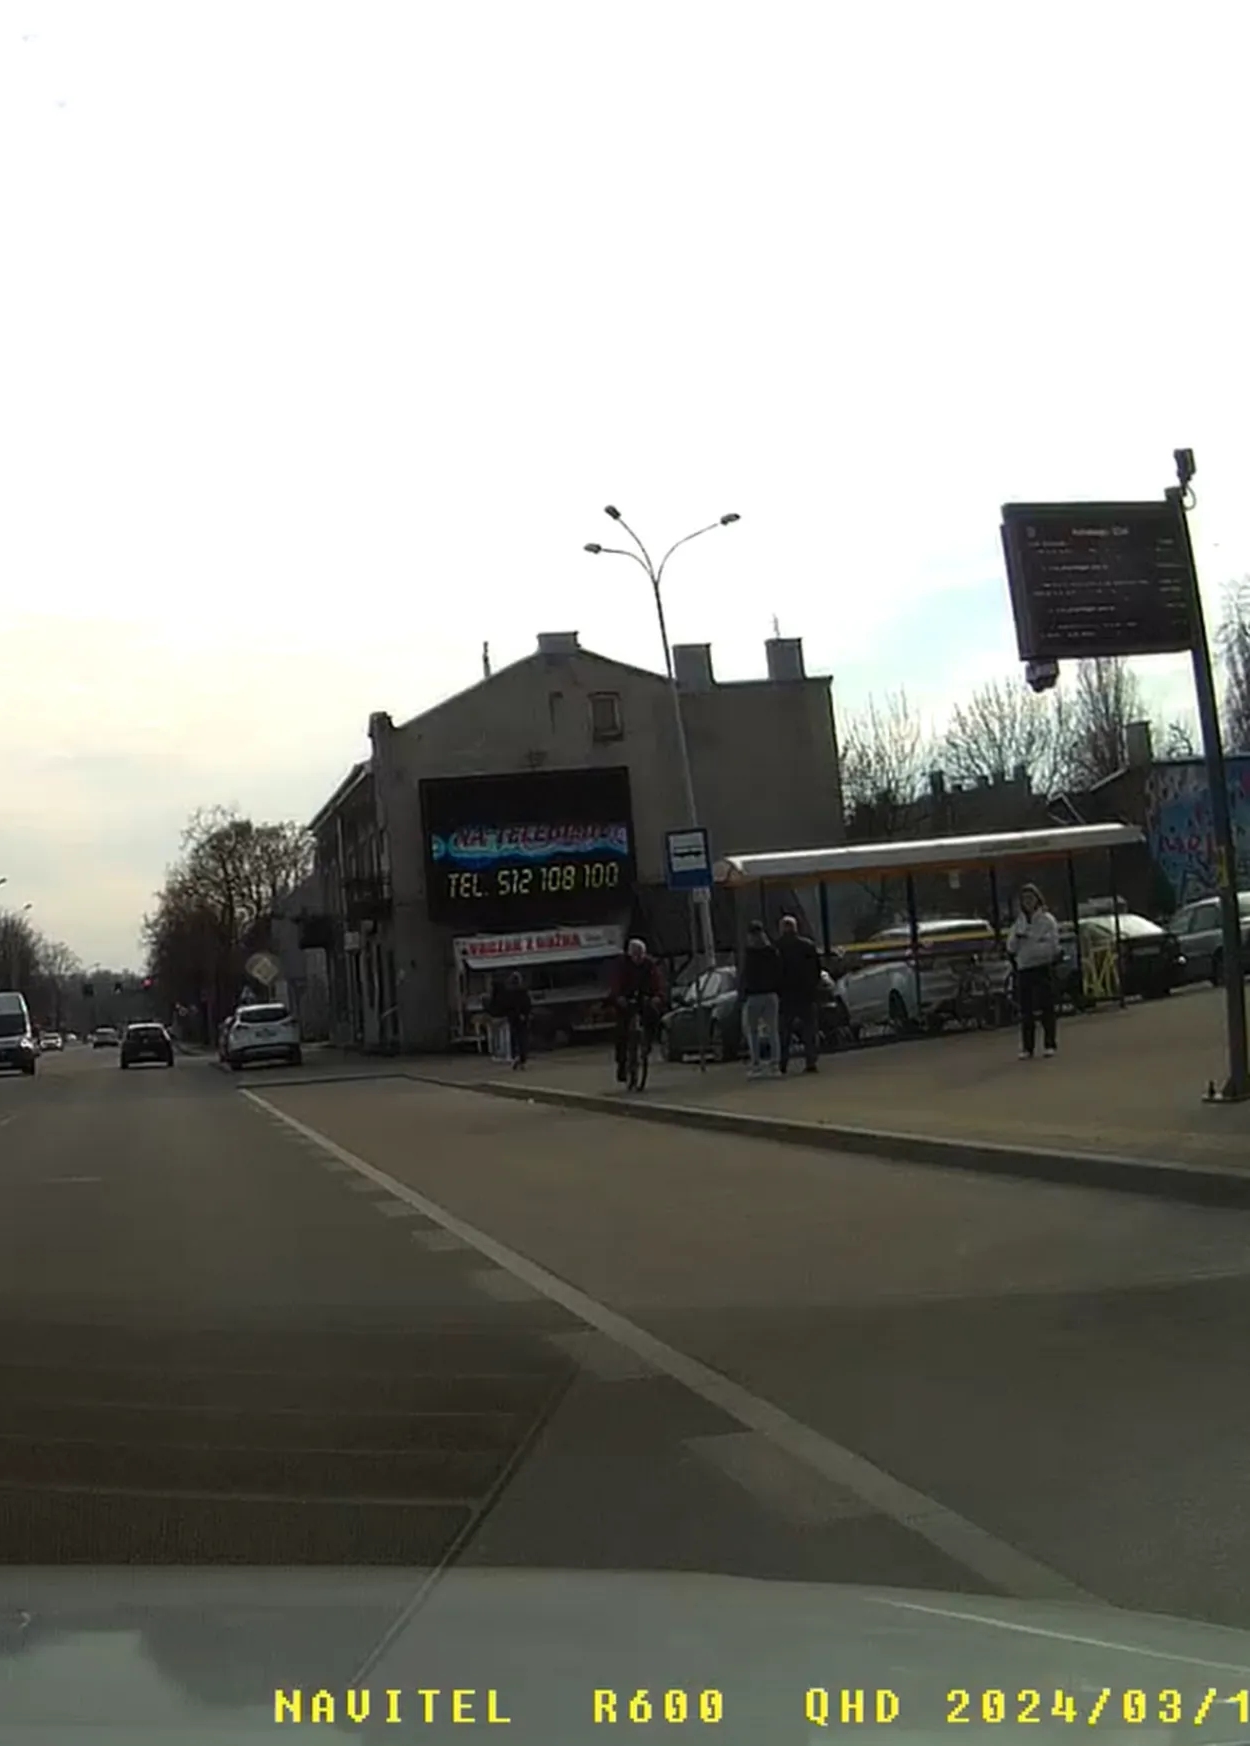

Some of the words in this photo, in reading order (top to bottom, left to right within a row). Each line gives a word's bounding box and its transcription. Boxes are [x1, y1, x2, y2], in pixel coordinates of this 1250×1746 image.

[448, 872, 489, 898] TEL.
[497, 868, 533, 896] 512
[540, 865, 575, 892] 108
[584, 861, 619, 887] 100
